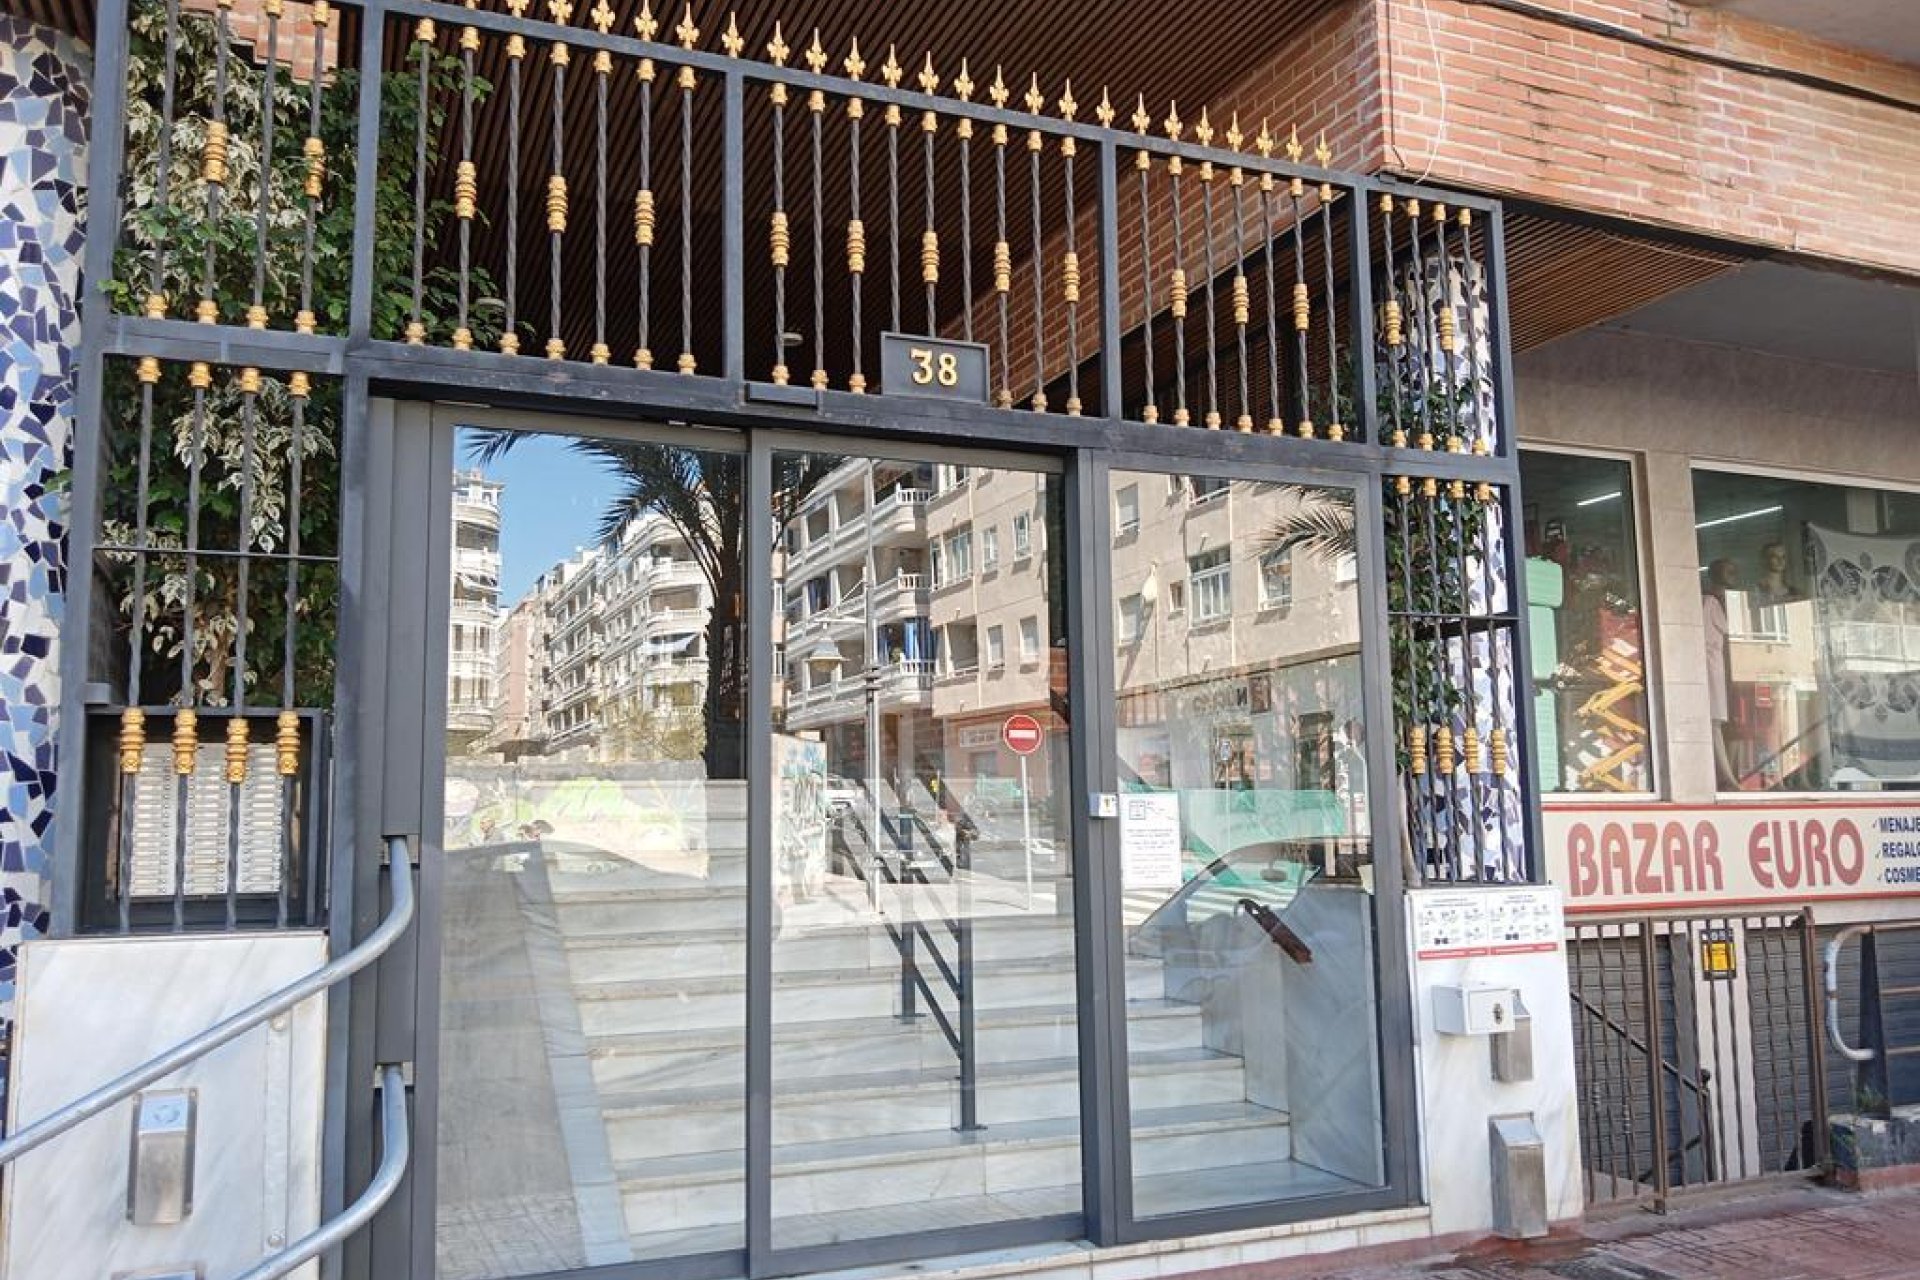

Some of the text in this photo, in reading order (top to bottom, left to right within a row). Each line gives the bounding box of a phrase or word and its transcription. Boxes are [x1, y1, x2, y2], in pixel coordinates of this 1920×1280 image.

[911, 347, 957, 386] 38
[1567, 818, 1864, 897] BAZAR EURO
